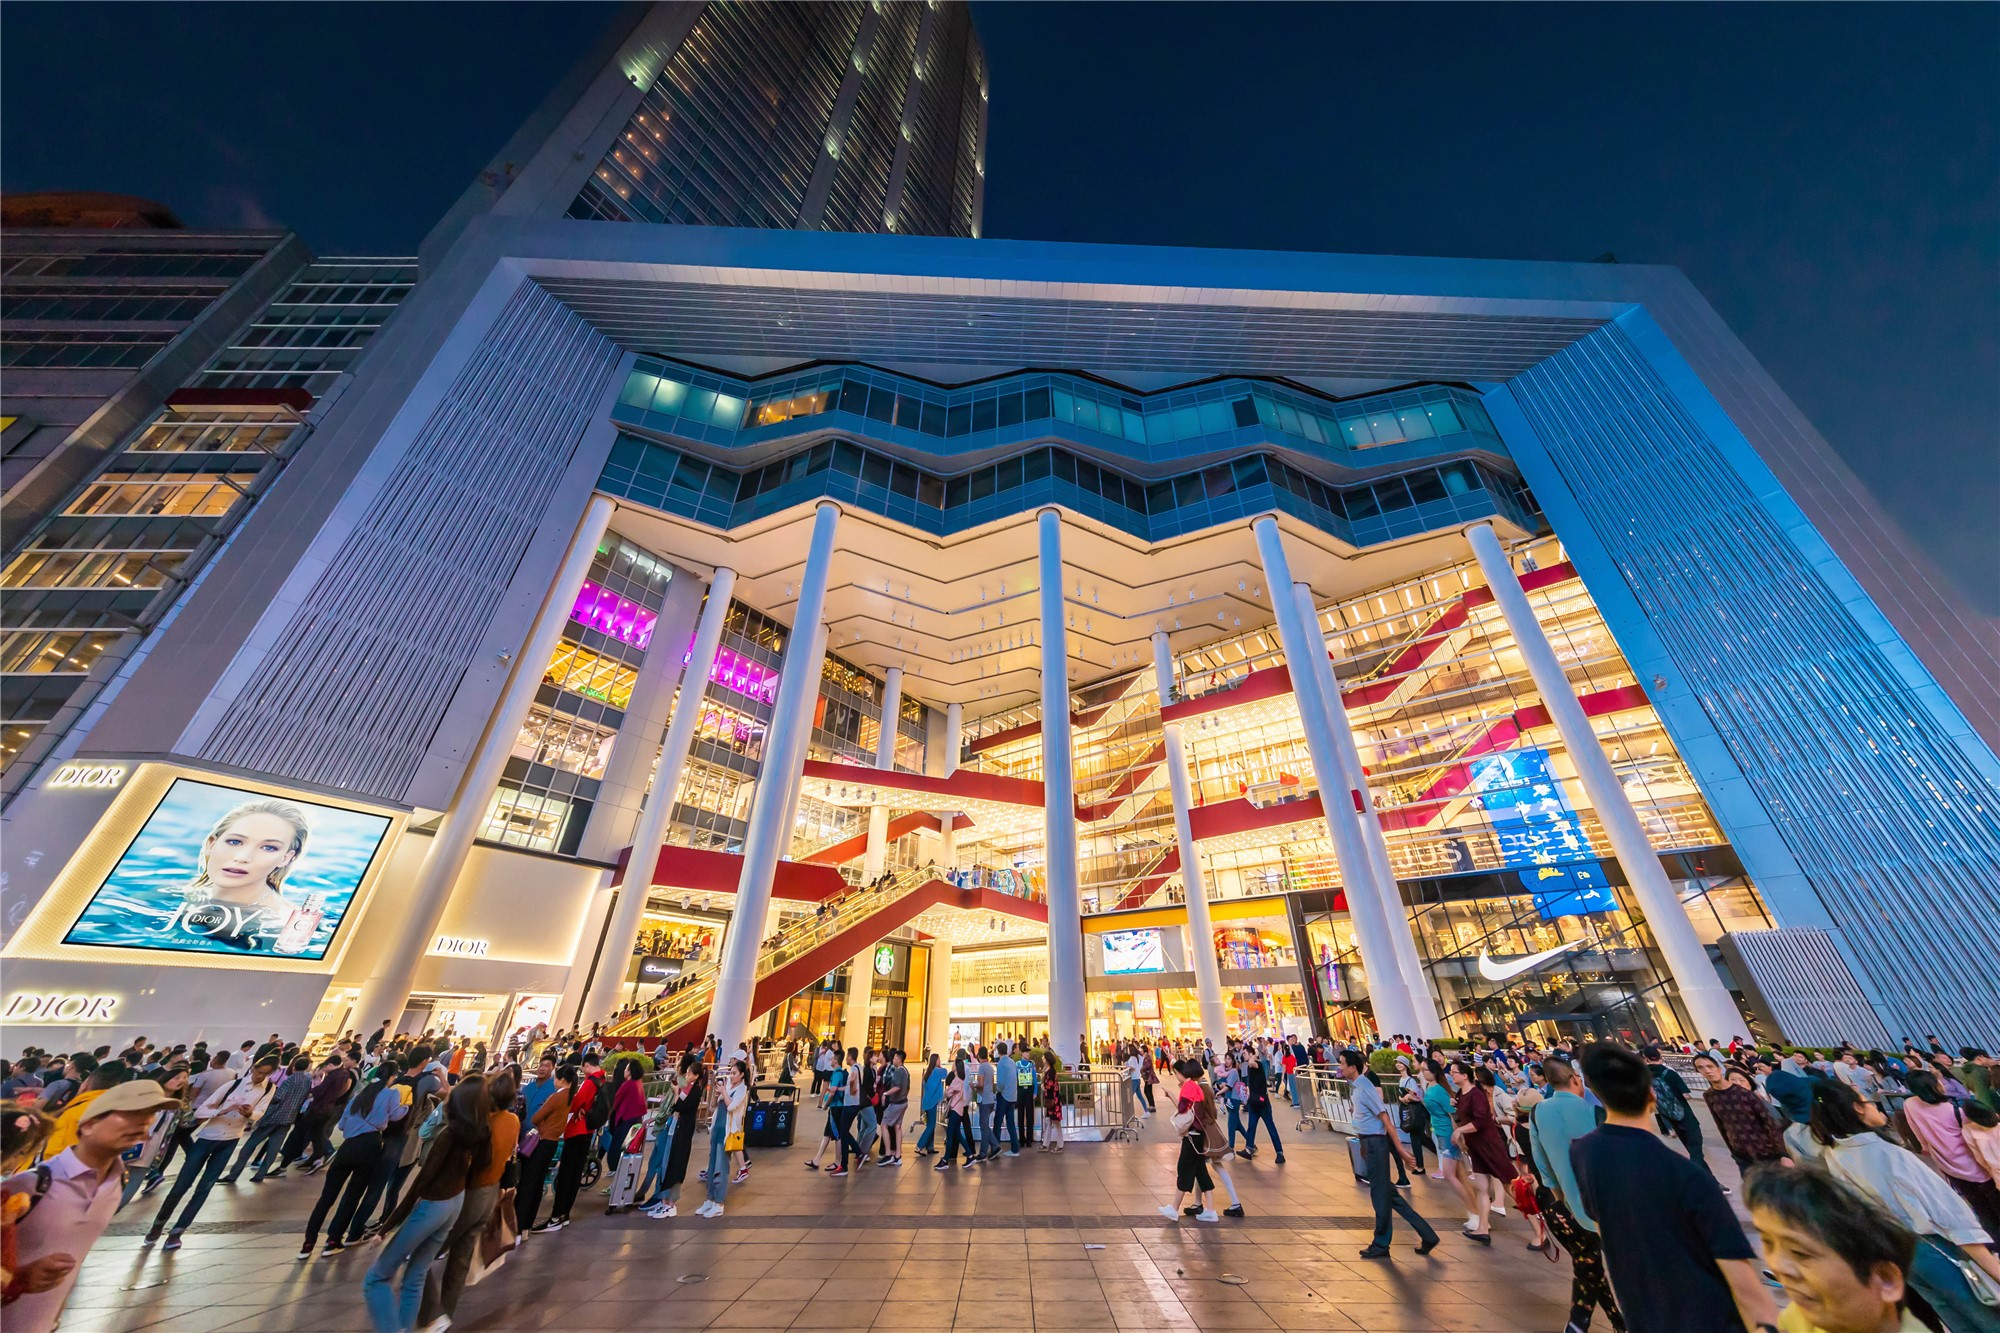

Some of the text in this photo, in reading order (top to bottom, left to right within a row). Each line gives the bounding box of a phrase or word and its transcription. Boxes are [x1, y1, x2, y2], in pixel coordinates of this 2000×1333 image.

[51, 767, 121, 785] DIOR
[145, 902, 264, 938] JOY
[191, 914, 223, 925] DIOR
[436, 937, 487, 955] DIOR
[983, 984, 1016, 994] ICICLE
[5, 995, 116, 1019] DIOR
